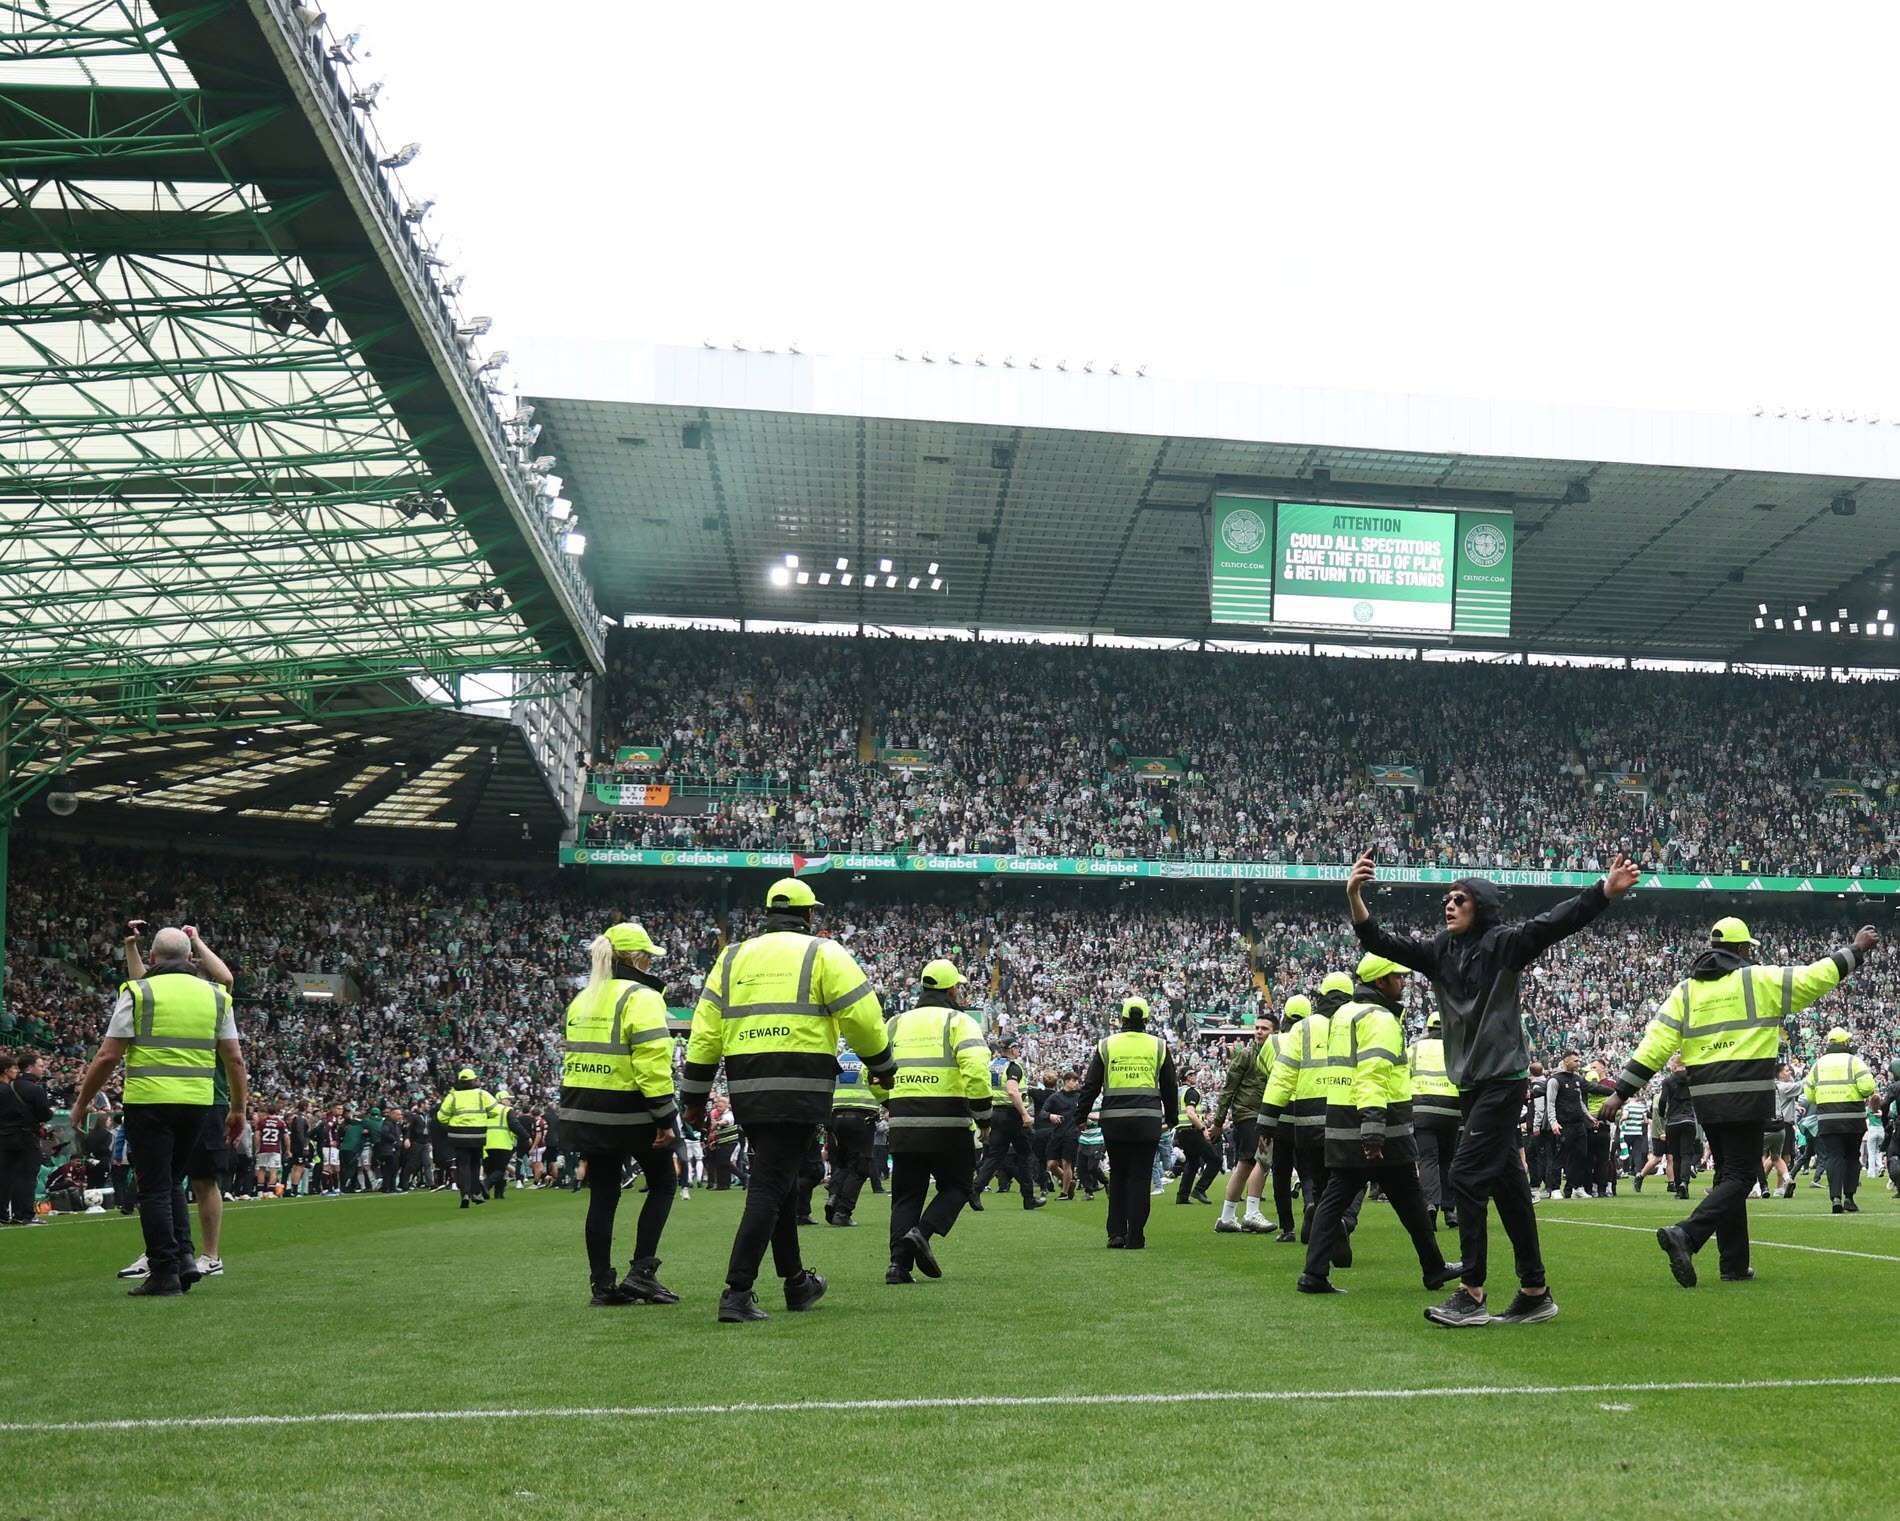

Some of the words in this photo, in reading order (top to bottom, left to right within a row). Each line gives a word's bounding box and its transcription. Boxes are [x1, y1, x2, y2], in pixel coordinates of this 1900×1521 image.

[1333, 516, 1401, 532] ATTENTION
[1290, 533, 1333, 549] COULD
[1335, 535, 1359, 551] ALL
[1361, 537, 1441, 556] SPECTATORS
[1221, 561, 1264, 569] CELTICFC.COM
[1286, 548, 1325, 565] LEAVE
[1327, 551, 1353, 567] THE
[1355, 552, 1392, 569] FIELD
[1394, 555, 1411, 570] OF
[1413, 556, 1444, 572] PLAY
[1284, 564, 1294, 579] &
[1296, 565, 1347, 582] RETURN
[1349, 568, 1366, 583] TO
[1368, 569, 1394, 585] THE
[1395, 570, 1445, 587] STANDS
[1463, 574, 1505, 582] CELTICFC.COM
[590, 850, 643, 862] dafabet
[677, 853, 729, 865] dafabet
[761, 854, 794, 866] dafa
[846, 855, 896, 868] dafabet
[928, 857, 978, 870] dafabet
[1010, 859, 1058, 871] dafabet
[1090, 861, 1138, 873] dafabet
[1194, 864, 1288, 878] LTICFC.NET/STORE
[739, 1026, 790, 1040] STEWARD
[840, 1061, 862, 1071] POLICE
[895, 1075, 939, 1084] TEWARD
[262, 1128, 280, 1142] 23
